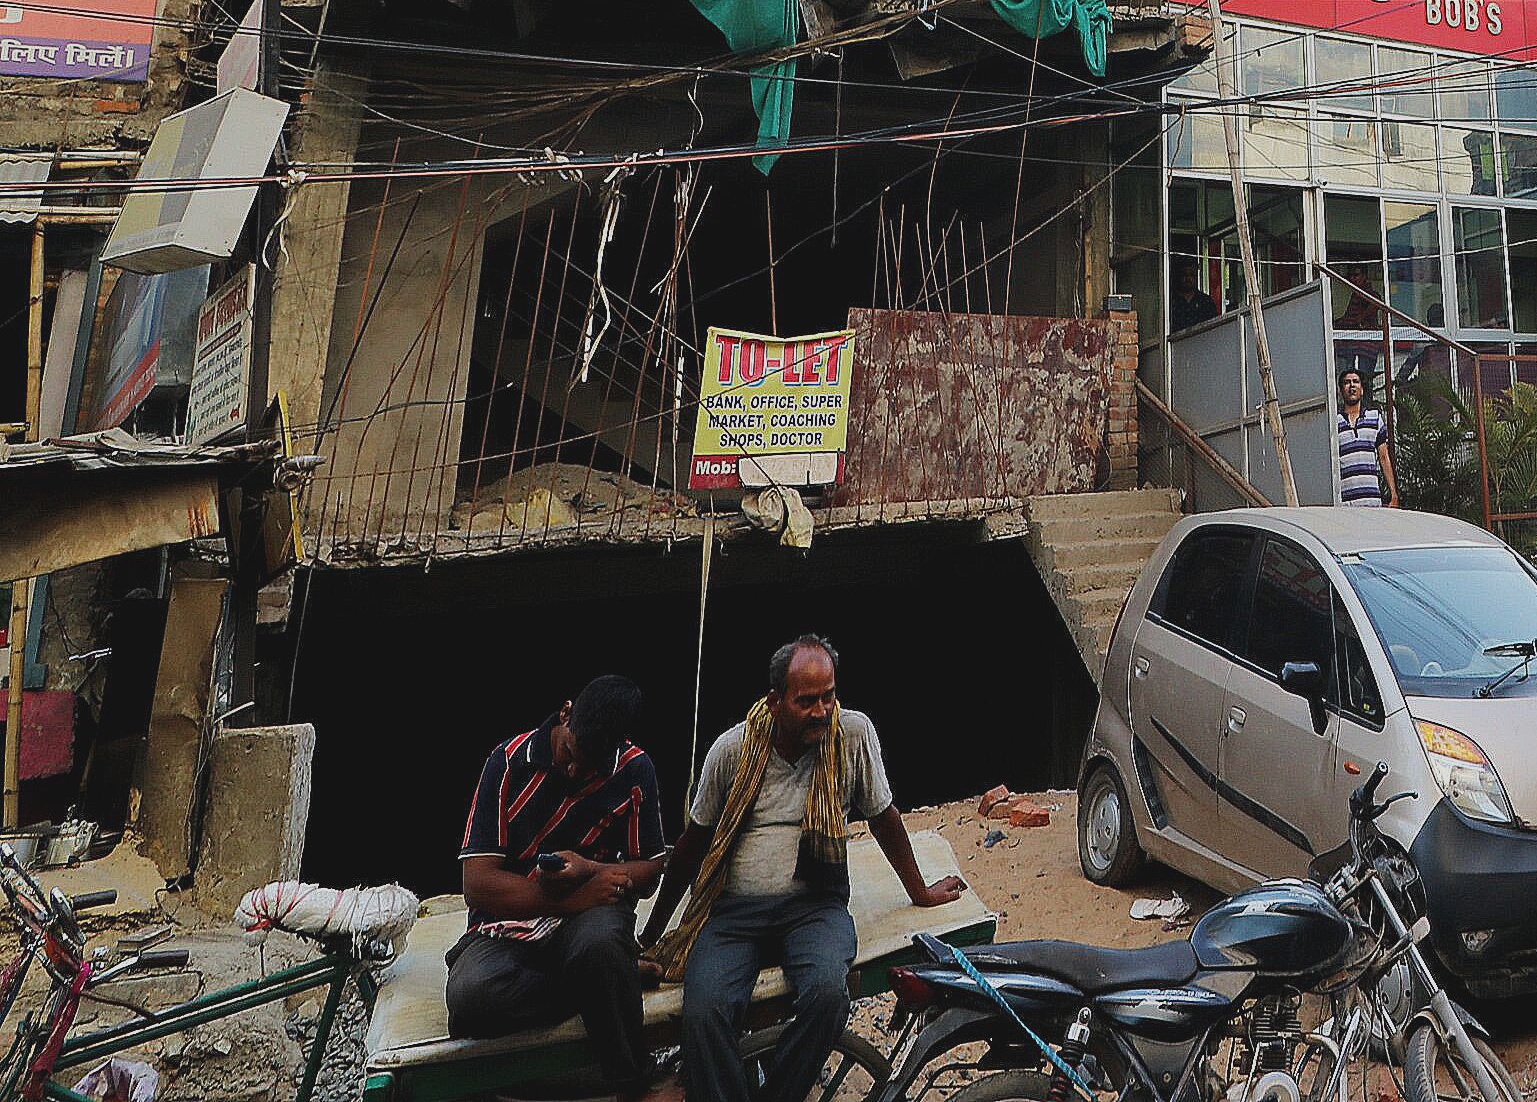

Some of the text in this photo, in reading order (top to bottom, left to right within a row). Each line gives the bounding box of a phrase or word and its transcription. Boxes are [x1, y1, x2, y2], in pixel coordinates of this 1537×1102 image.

[715, 335, 848, 386] TO-LET
[706, 394, 842, 411] BANK, OFFICE, SUPER
[708, 413, 836, 431] MARKET, COACHING
[719, 432, 823, 449] SHOPS, DOCTOR
[695, 460, 736, 475] Mob:
